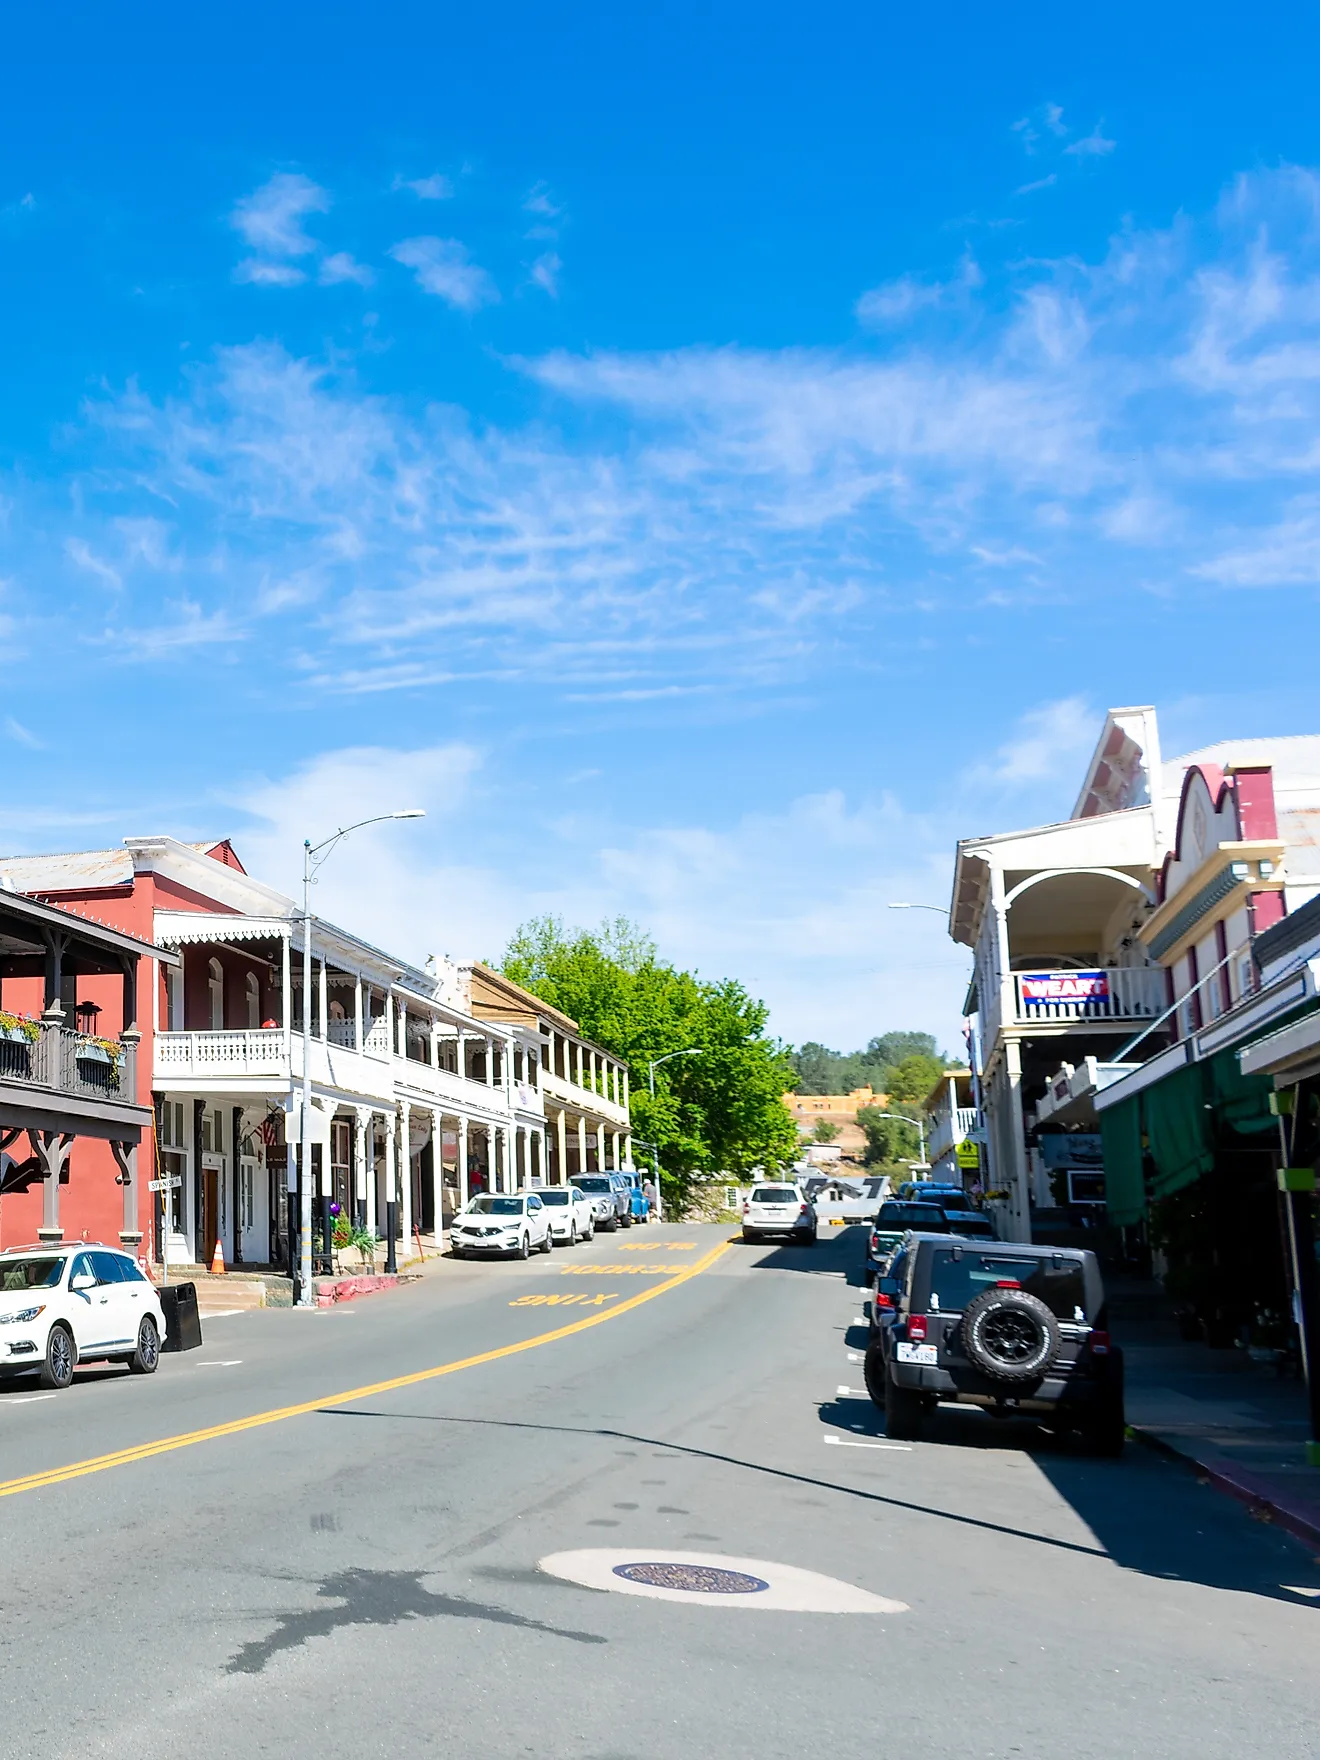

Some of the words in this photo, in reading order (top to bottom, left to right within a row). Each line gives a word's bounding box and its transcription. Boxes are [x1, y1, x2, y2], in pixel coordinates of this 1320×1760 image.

[1024, 979, 1104, 997] WEART
[560, 1264, 691, 1275] SCHOOL
[508, 1293, 620, 1306] XING
